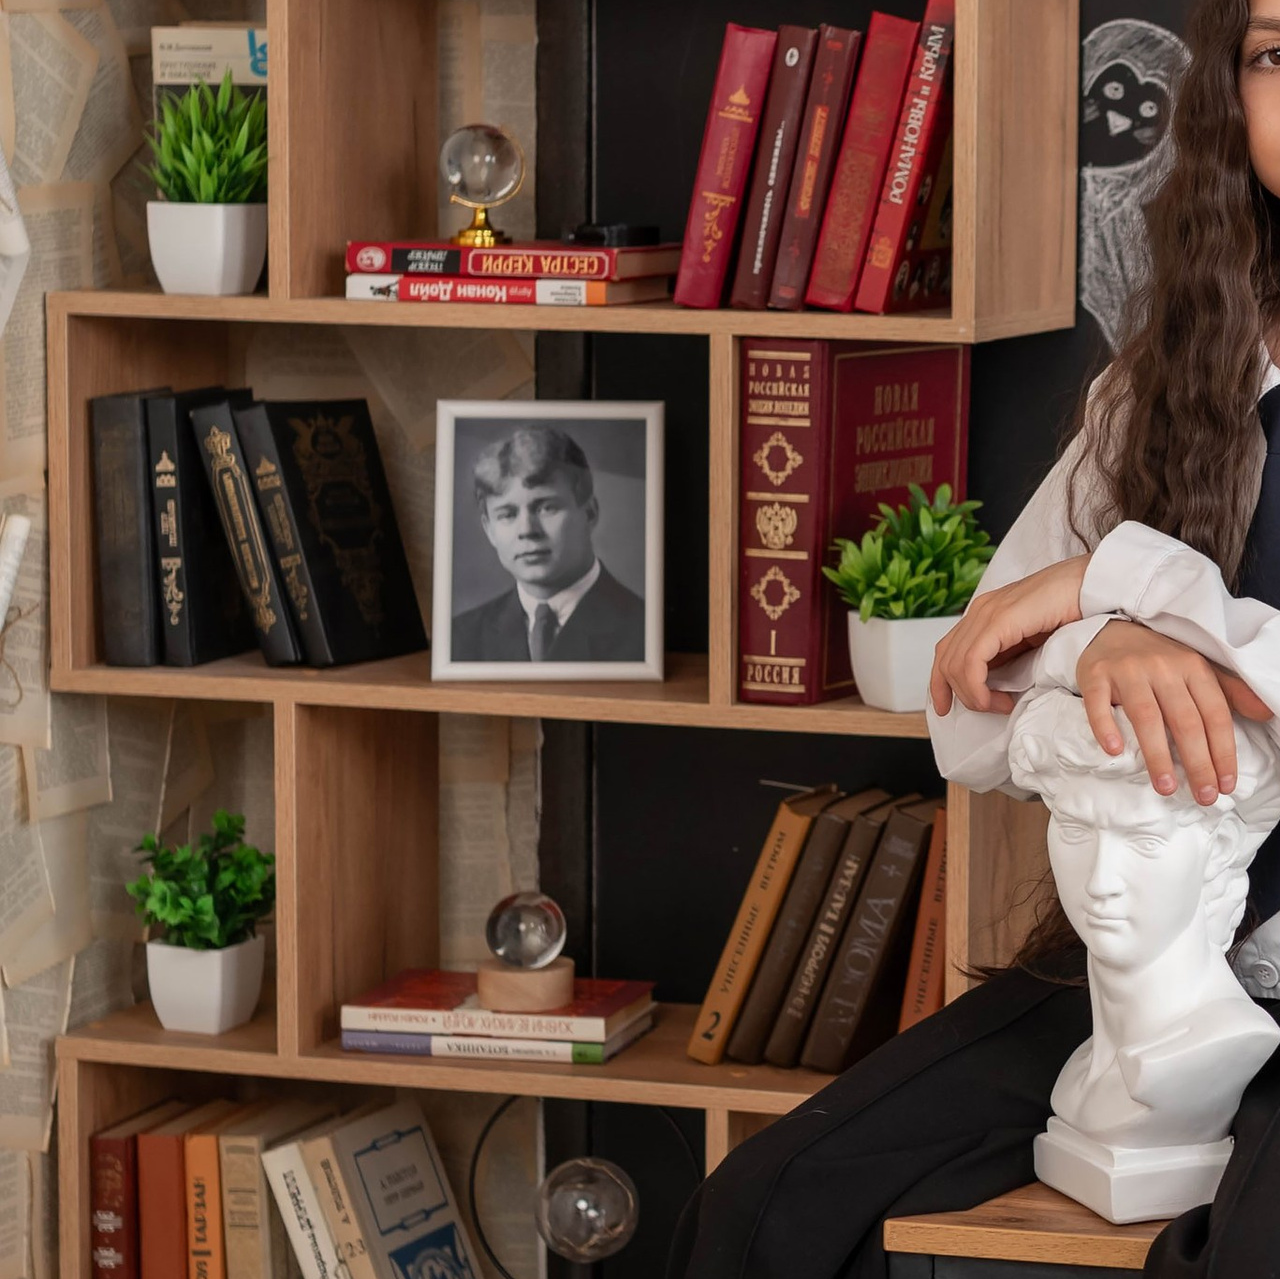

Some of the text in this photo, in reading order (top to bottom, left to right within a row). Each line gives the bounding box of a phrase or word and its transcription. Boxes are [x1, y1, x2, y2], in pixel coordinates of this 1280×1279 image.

[889, 98, 928, 205] РОМАНОВЫ
[919, 24, 946, 82] КРЫМ
[481, 255, 600, 274] СЕСТРА КЕРРИ
[410, 282, 453, 301] Дойл
[457, 284, 507, 302] Конан
[748, 381, 810, 397] РОССИЙСКАЯ
[874, 382, 919, 416] НОВАЯ
[856, 417, 935, 455] РОССИЙСКАЯ
[746, 664, 800, 685] РОССИЯ
[720, 831, 787, 995] УНЕСЕННЫЕ ВЕТРОМ
[914, 918, 938, 1014] УНЕСЕННЫЕ
[701, 1011, 721, 1041] 2
[446, 1041, 509, 1055] БОТАНИКА
